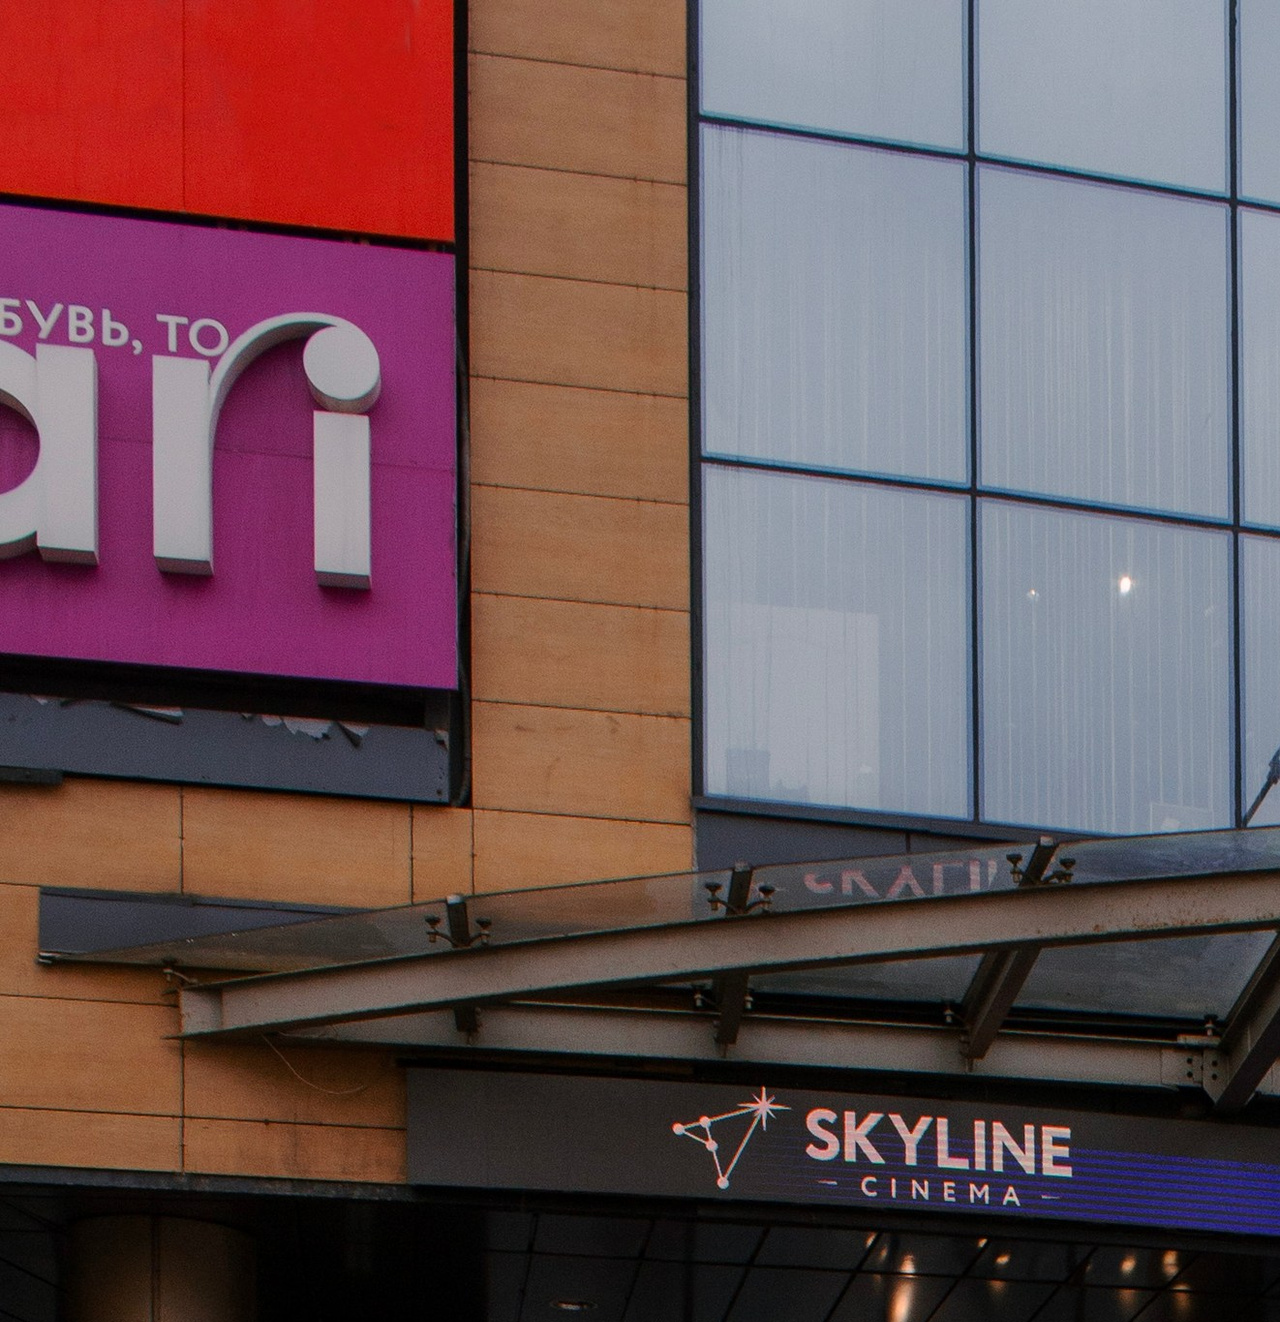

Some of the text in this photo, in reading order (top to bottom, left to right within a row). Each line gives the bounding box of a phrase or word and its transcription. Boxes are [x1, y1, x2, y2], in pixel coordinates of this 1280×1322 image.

[157, 313, 230, 357] ТО
[804, 1107, 1073, 1178] SKYLINE
[860, 1175, 1021, 1207] CINEMA
